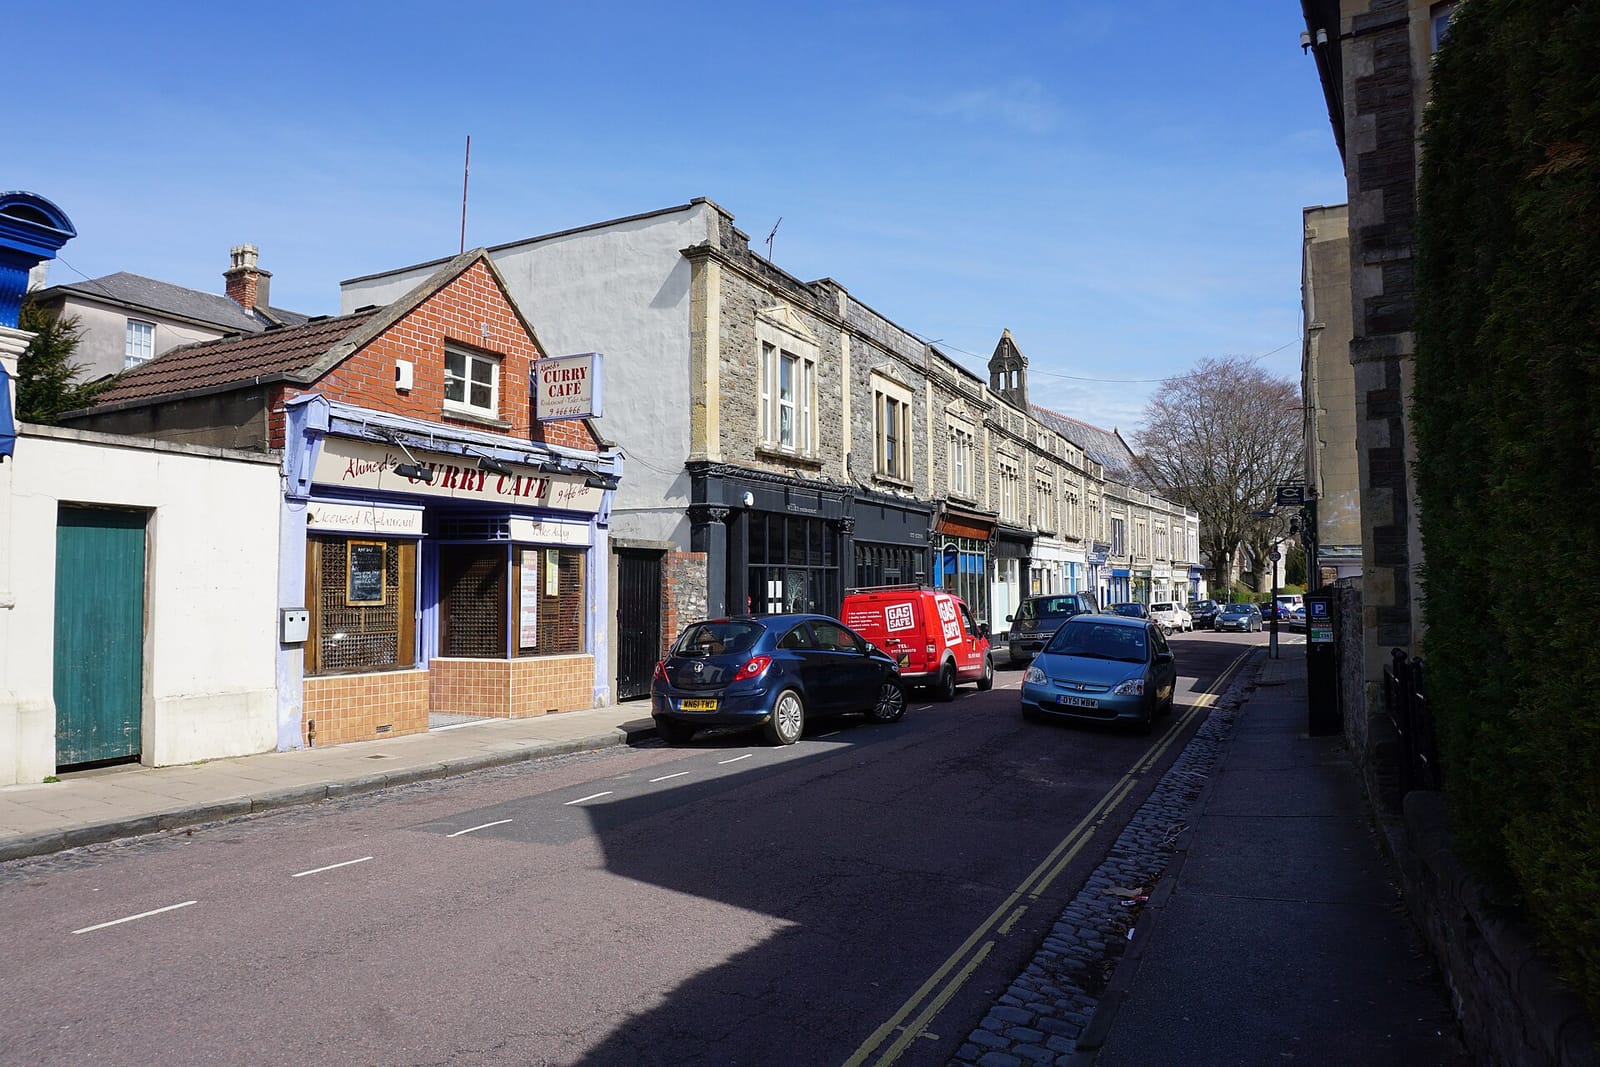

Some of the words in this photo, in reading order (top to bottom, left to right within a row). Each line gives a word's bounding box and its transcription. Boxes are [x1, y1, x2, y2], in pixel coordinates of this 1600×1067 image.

[544, 367, 588, 384] CURRY
[549, 380, 582, 398] CAFÉ
[342, 453, 398, 481] Ahmed's
[497, 473, 550, 499] CAFÉ
[888, 606, 910, 620] GAS
[1315, 604, 1324, 614] P
[889, 617, 911, 629] SAFE
